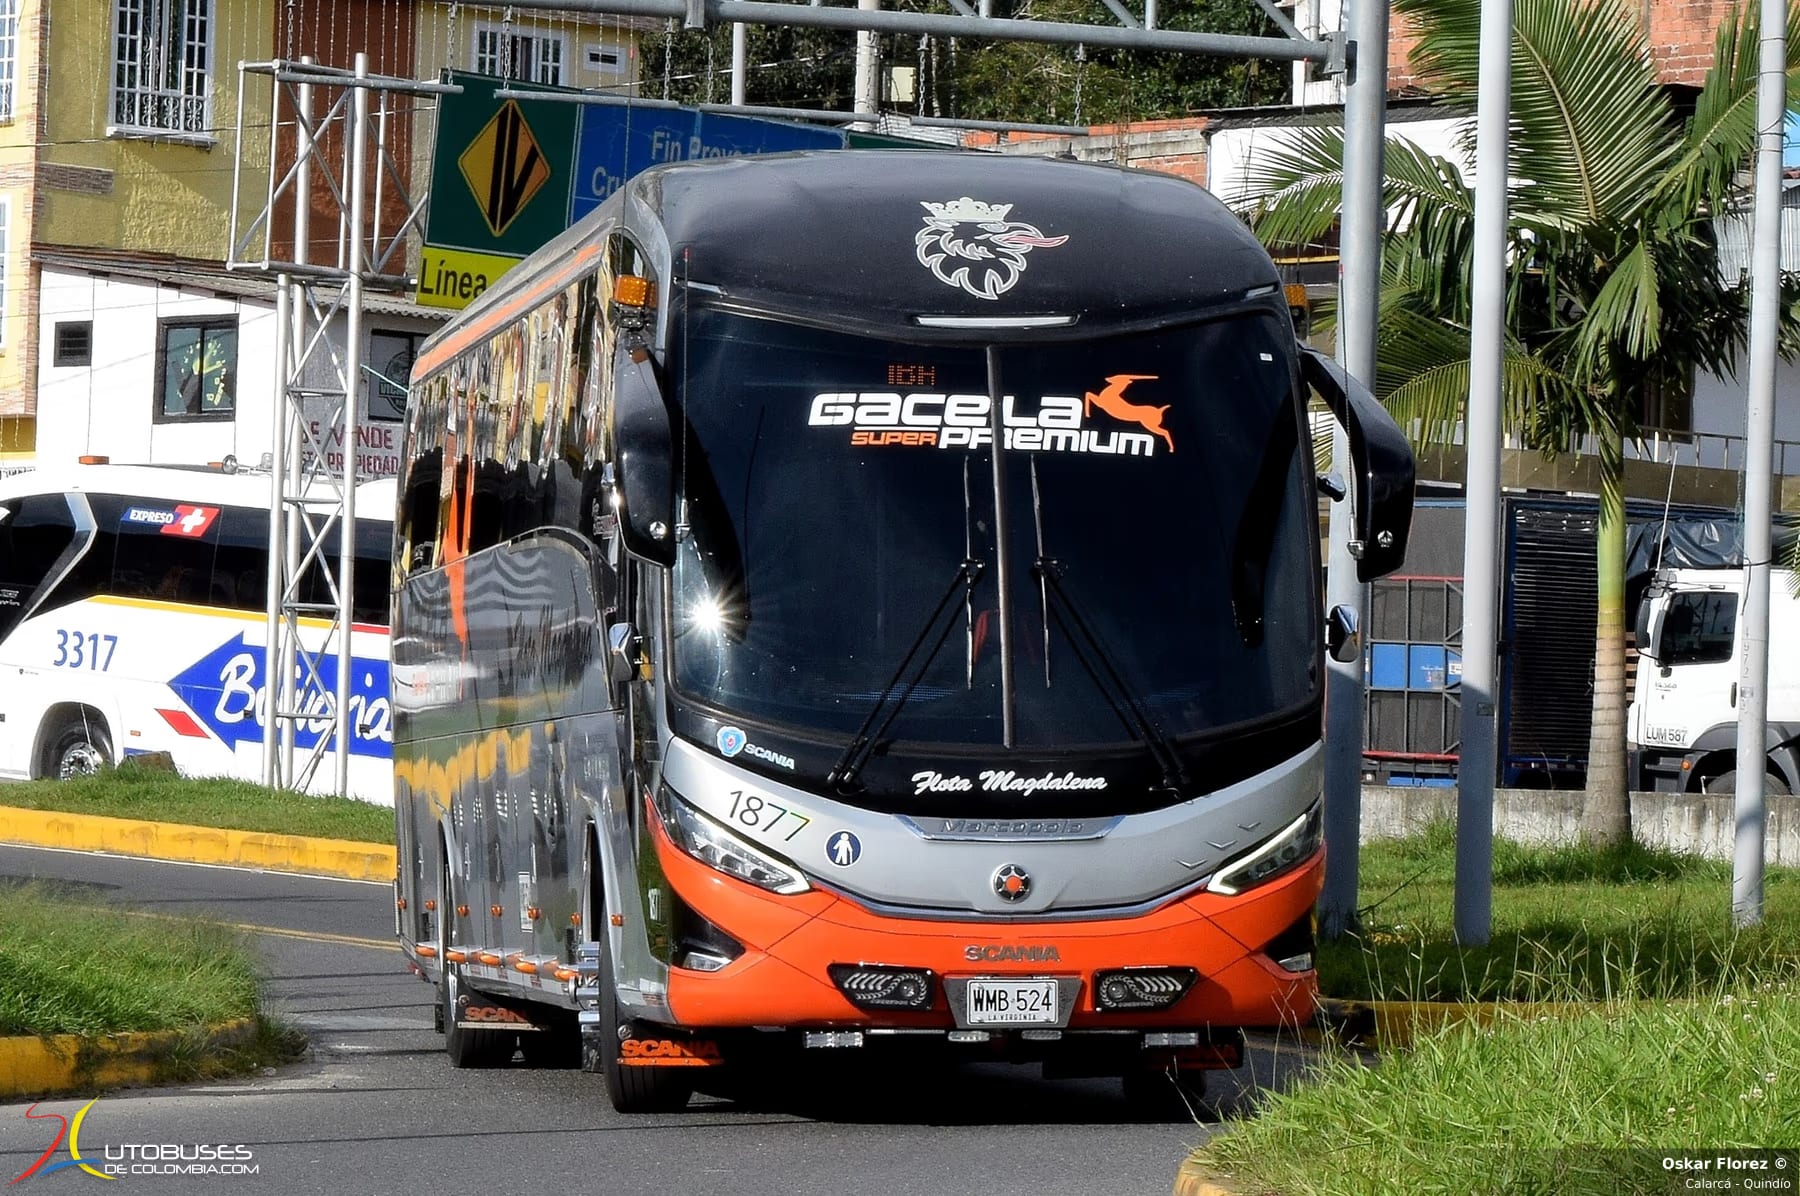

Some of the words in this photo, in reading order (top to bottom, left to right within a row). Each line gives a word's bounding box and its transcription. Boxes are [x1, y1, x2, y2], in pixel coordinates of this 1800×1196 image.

[652, 131, 682, 162] Fin
[420, 258, 487, 299] Línea
[332, 424, 393, 449] VNDE
[851, 432, 936, 446] SUPER
[129, 509, 174, 524] EXPRESO
[53, 629, 118, 672] 3317
[744, 743, 796, 770] SCANIA
[911, 771, 973, 795] Flota
[979, 770, 1108, 797] Magdalena
[730, 790, 810, 842] 1877
[941, 819, 1083, 835] Marcopolo
[964, 945, 1061, 962] SCANIA
[973, 990, 1009, 1011] WMB
[1016, 990, 1052, 1011] 524
